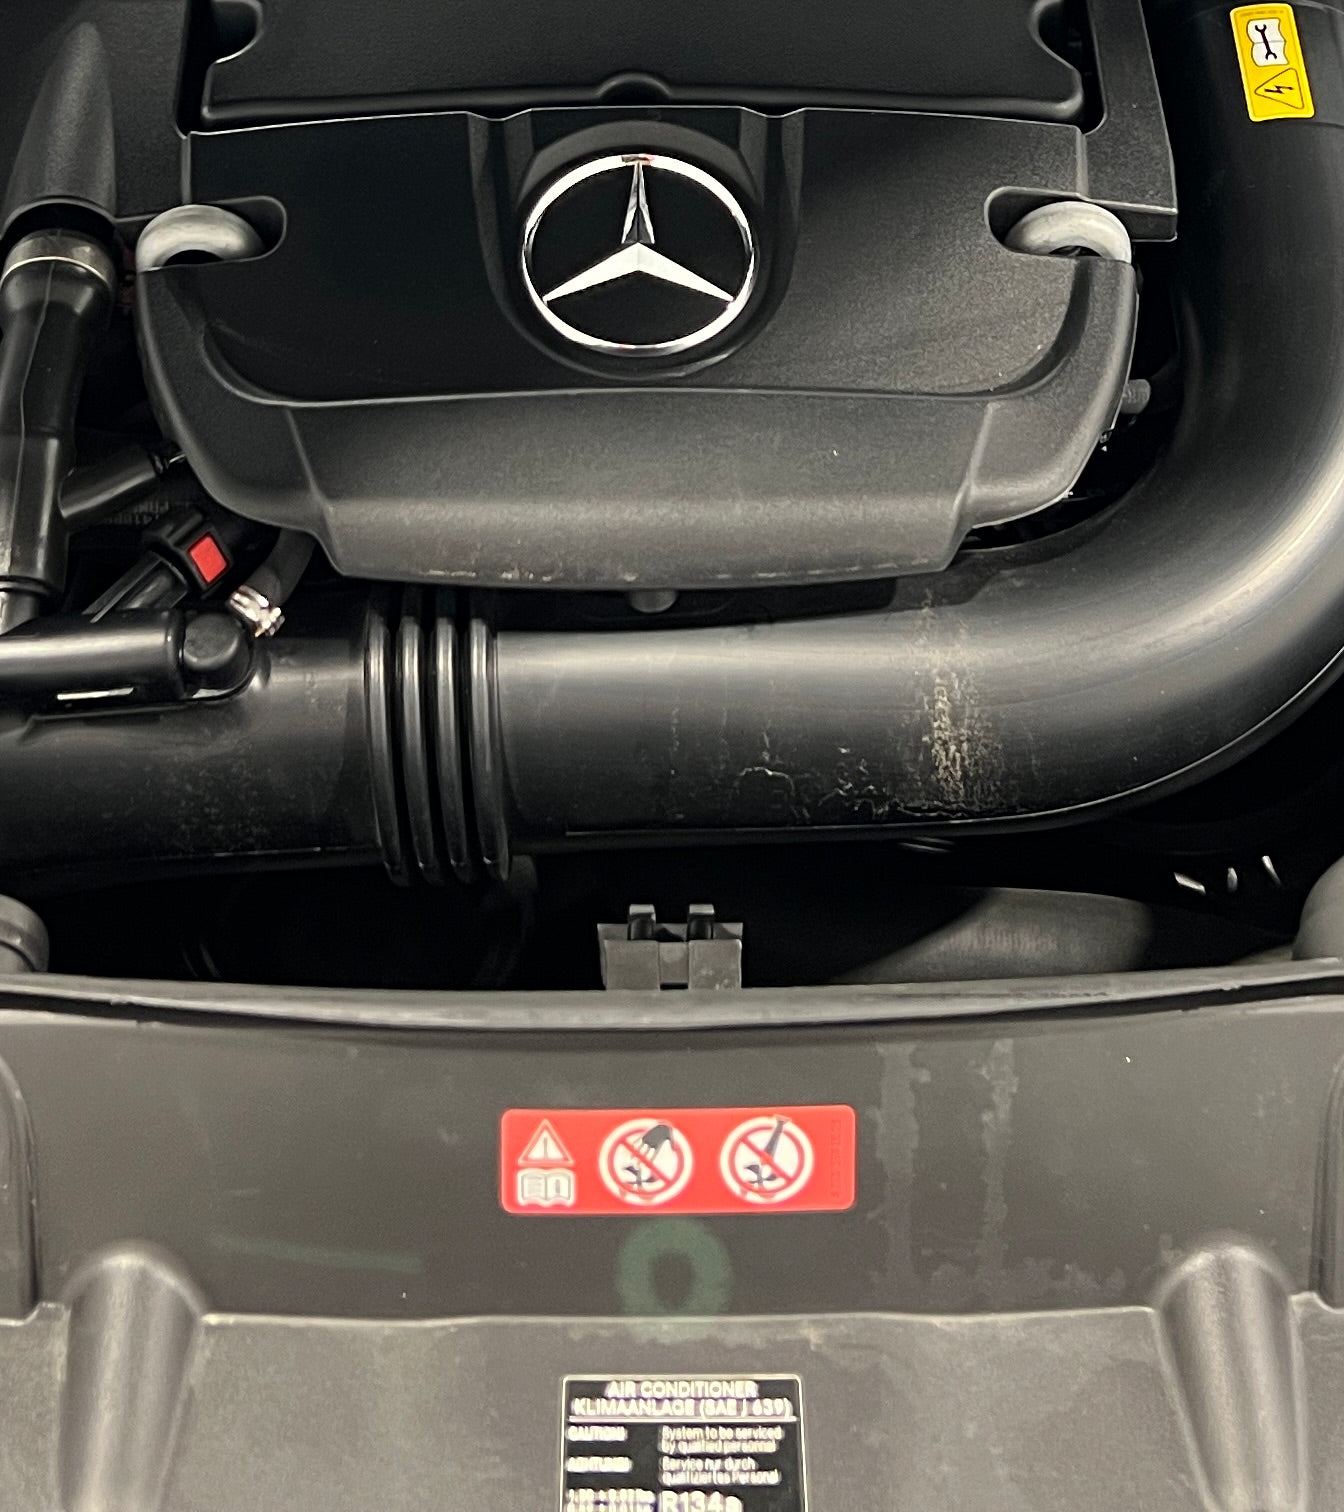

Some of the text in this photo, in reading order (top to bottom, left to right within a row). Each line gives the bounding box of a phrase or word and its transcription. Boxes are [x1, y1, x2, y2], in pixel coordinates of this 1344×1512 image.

[606, 1380, 759, 1399] AIR CONDITIONER
[572, 1397, 695, 1417] KLIMAANLAGE
[699, 1397, 737, 1419] (SAE
[752, 1397, 794, 1418] 639)
[661, 1424, 784, 1441] System to be serviced
[660, 1439, 675, 1455] by
[661, 1455, 704, 1472] Service
[723, 1456, 758, 1471] durch
[732, 1469, 782, 1485] Personal
